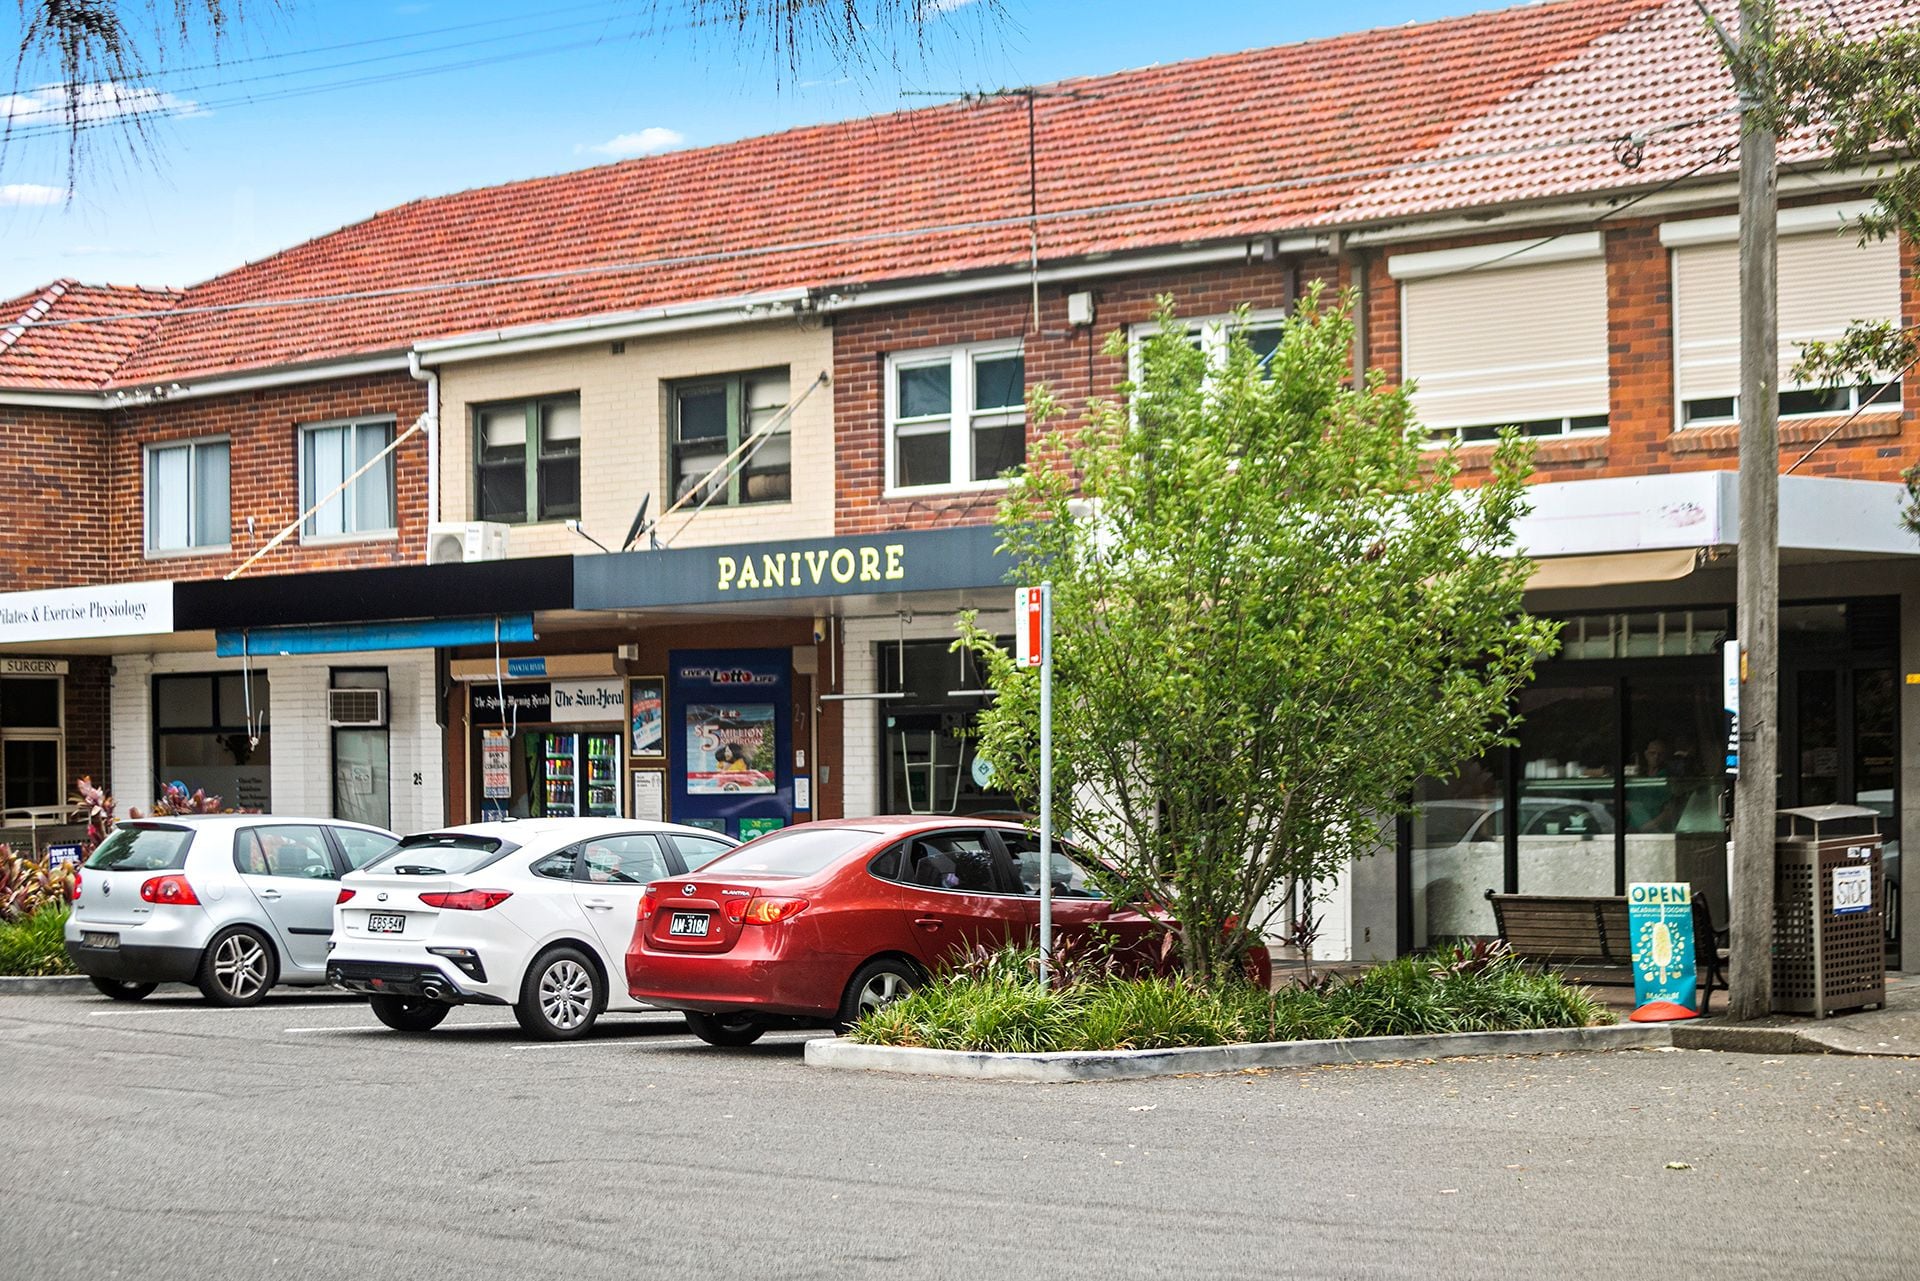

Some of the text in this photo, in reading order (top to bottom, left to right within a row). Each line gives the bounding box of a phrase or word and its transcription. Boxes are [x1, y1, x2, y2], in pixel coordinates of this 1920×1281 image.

[718, 544, 904, 590] PANIVORE
[31, 606, 39, 622] &
[43, 602, 86, 621] Exercise
[89, 599, 147, 622] Physiology
[7, 660, 58, 672] SURGERY
[474, 697, 486, 708] The
[531, 693, 550, 708] Herald
[555, 690, 574, 708] The
[720, 728, 764, 740] MILLION
[413, 772, 422, 785] 25
[1632, 885, 1685, 903] OPEN
[1837, 879, 1868, 905] STOP
